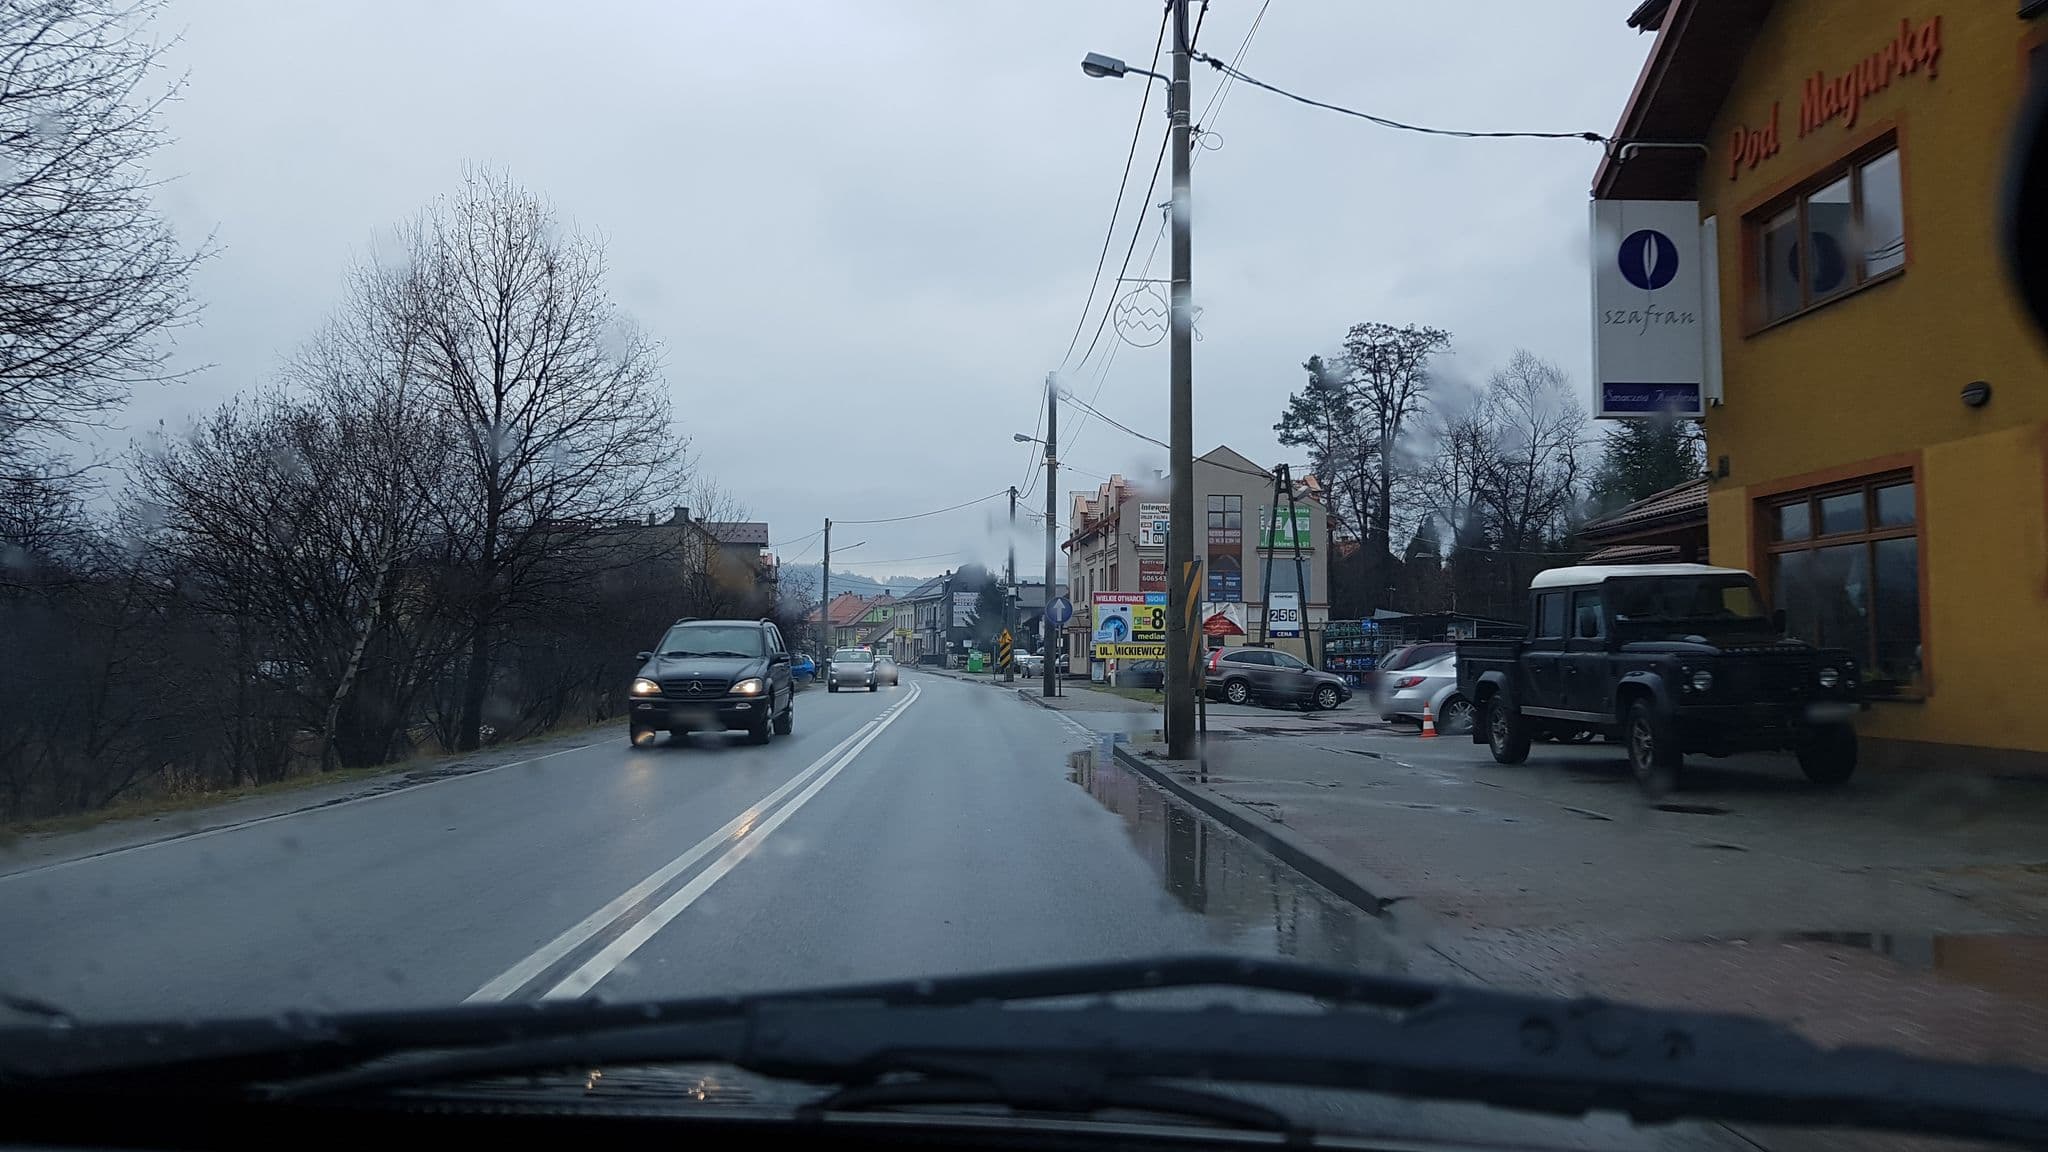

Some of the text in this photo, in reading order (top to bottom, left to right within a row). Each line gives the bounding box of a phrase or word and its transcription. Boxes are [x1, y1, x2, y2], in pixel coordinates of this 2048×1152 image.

[1728, 15, 1942, 182] Pod Magurką
[1604, 303, 1696, 336] szafran
[1151, 608, 1167, 630] 8
[1099, 646, 1113, 656] UL.
